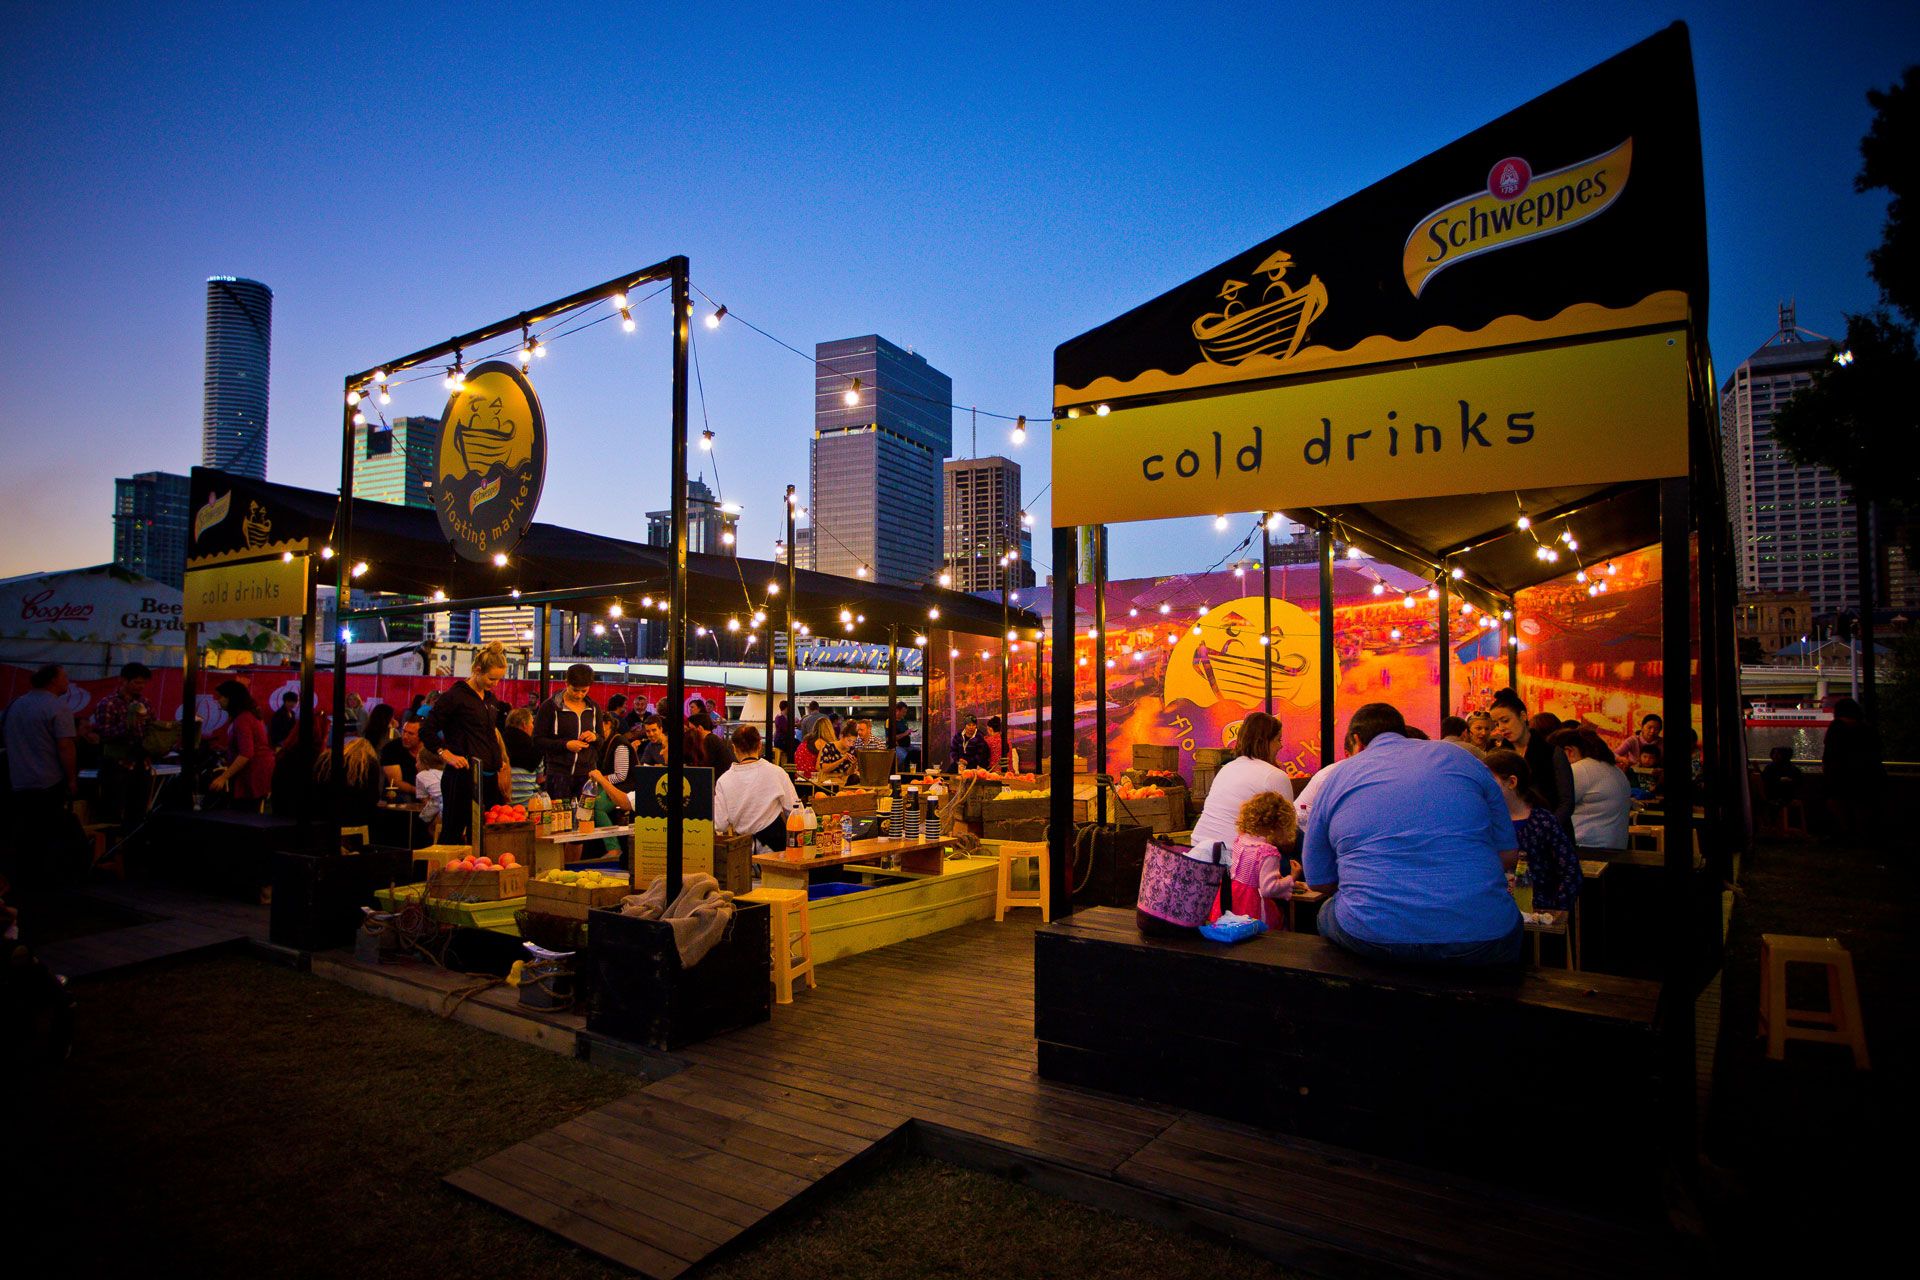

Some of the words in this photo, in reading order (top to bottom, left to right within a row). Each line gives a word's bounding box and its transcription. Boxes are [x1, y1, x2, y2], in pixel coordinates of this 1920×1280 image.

[1426, 169, 1607, 263] Schweppes
[1142, 426, 1262, 481] cold
[1303, 399, 1535, 467] drinks
[442, 489, 487, 552] floating
[492, 471, 533, 541] market
[141, 598, 183, 615] Bee
[202, 584, 228, 604] cold
[235, 577, 280, 600] drinks
